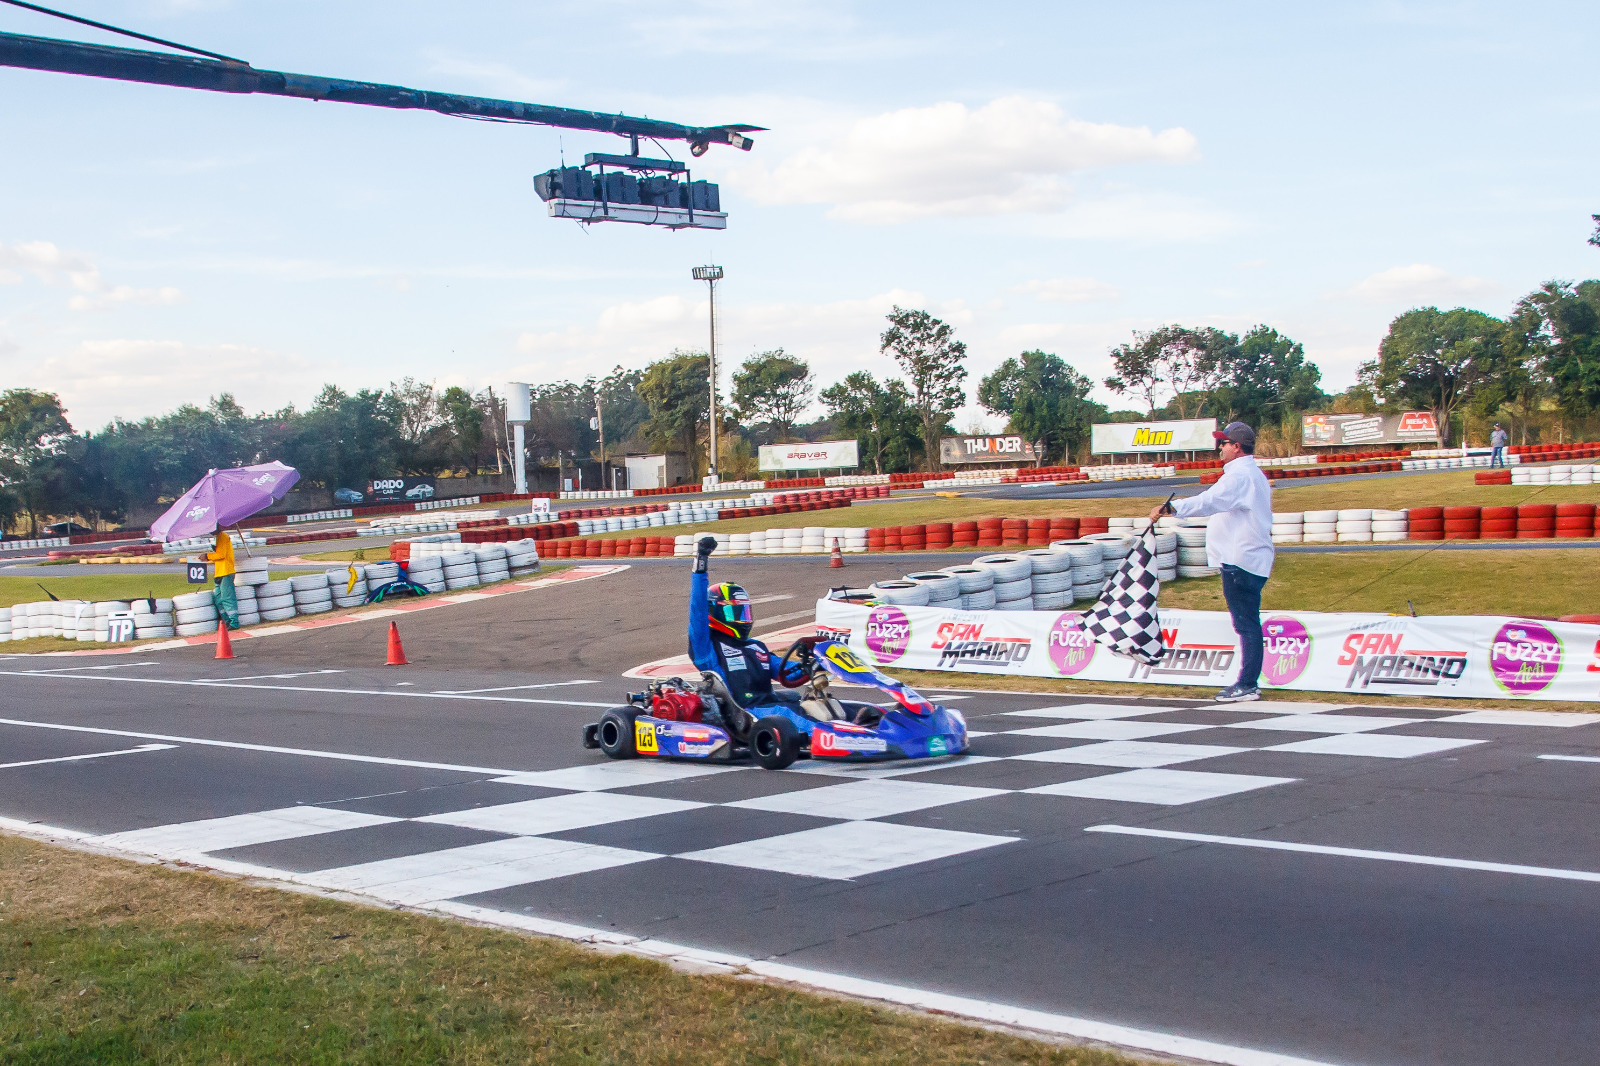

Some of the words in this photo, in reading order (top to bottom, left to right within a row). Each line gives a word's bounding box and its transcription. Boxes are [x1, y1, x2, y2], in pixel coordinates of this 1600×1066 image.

[964, 437, 1021, 454] THUNDER
[374, 480, 404, 490] DADO
[190, 567, 205, 579] 02
[109, 620, 134, 643] TP
[867, 622, 909, 639] FUZZY
[931, 623, 984, 649] SAN
[937, 641, 1031, 668] MARINO
[1337, 634, 1404, 665] SAN
[1493, 642, 1558, 661] FUZZY
[1345, 656, 1467, 689] MARINO
[638, 727, 653, 747] 125
